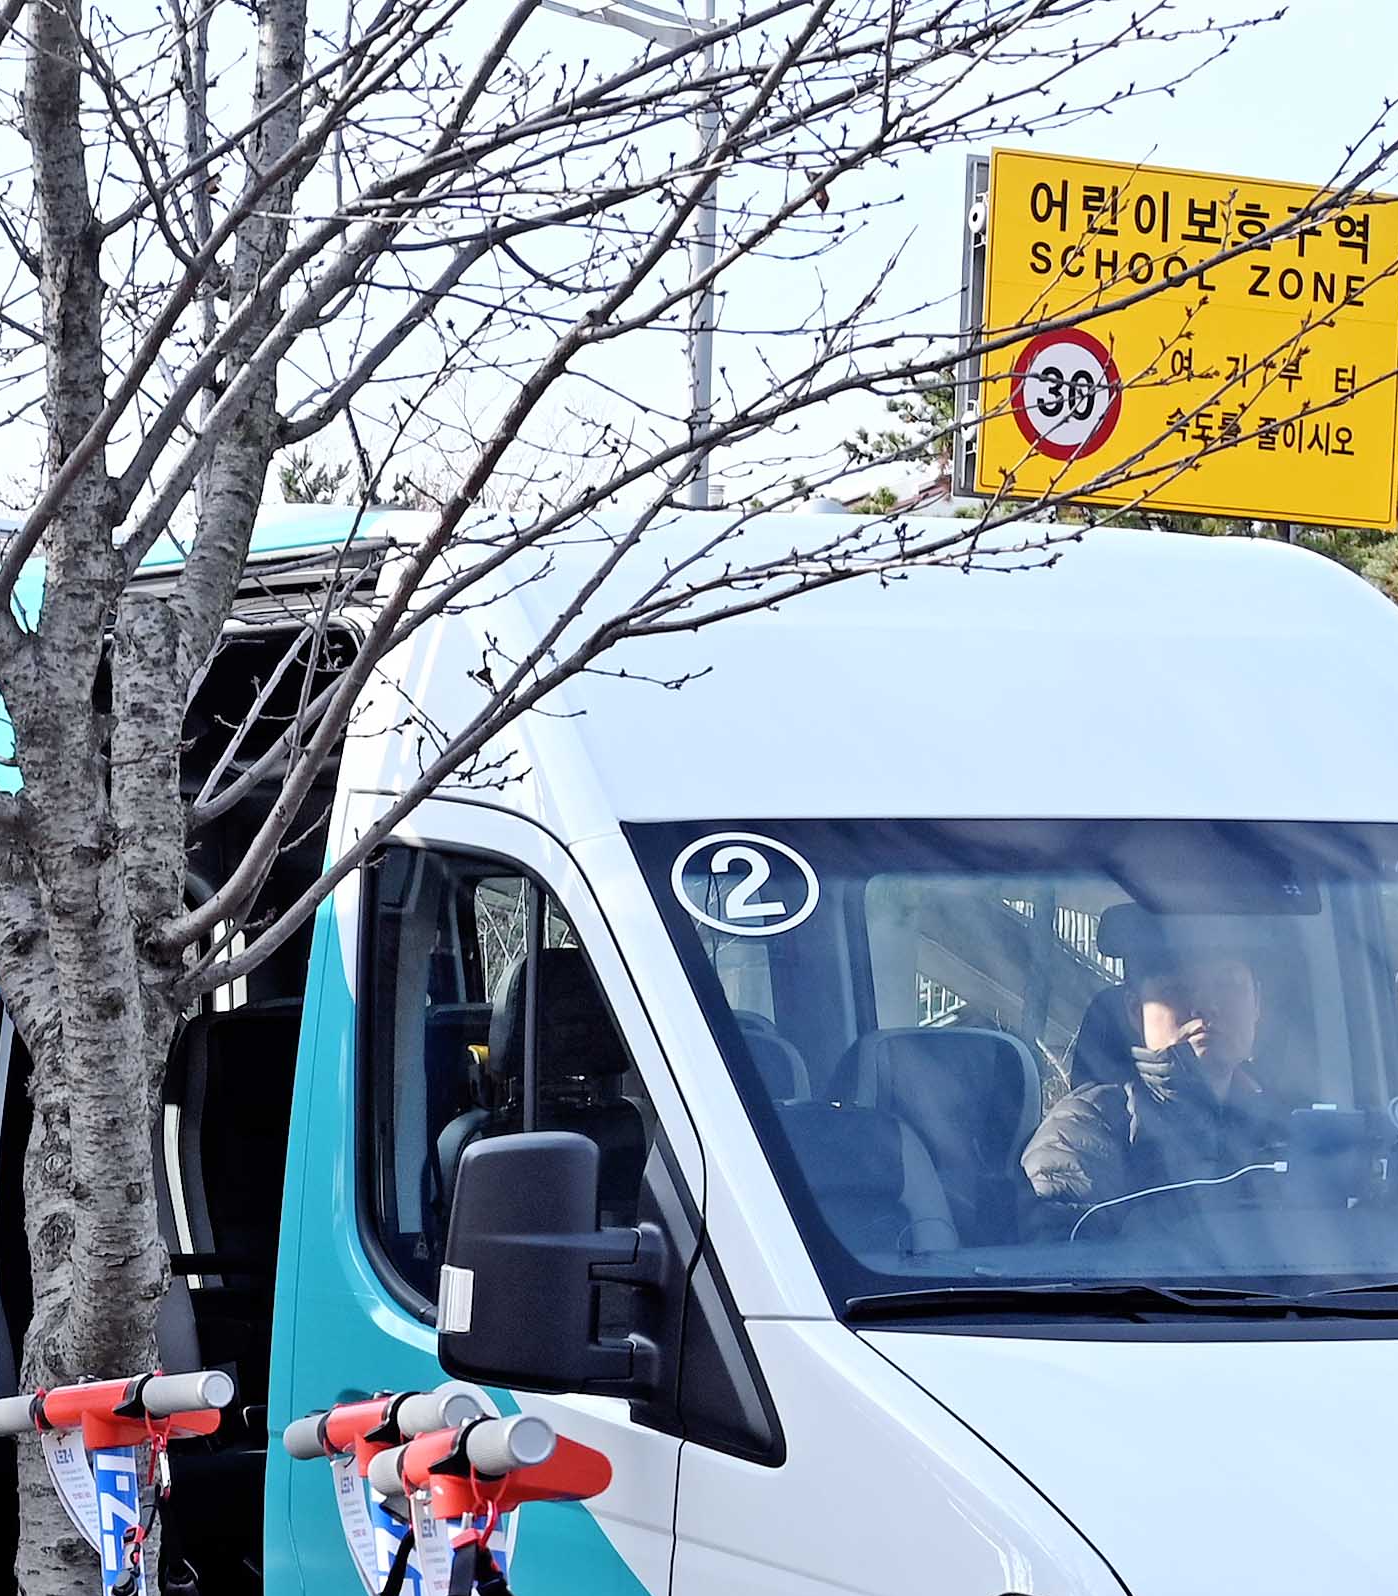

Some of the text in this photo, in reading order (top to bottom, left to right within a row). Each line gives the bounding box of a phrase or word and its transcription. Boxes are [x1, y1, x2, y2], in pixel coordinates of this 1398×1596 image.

[1030, 179, 1371, 265] 어린이보호구역
[1029, 241, 1366, 307] SCHOOL ZONE
[1036, 366, 1095, 421] 30
[1165, 407, 1355, 457] 속도를 줄이시오
